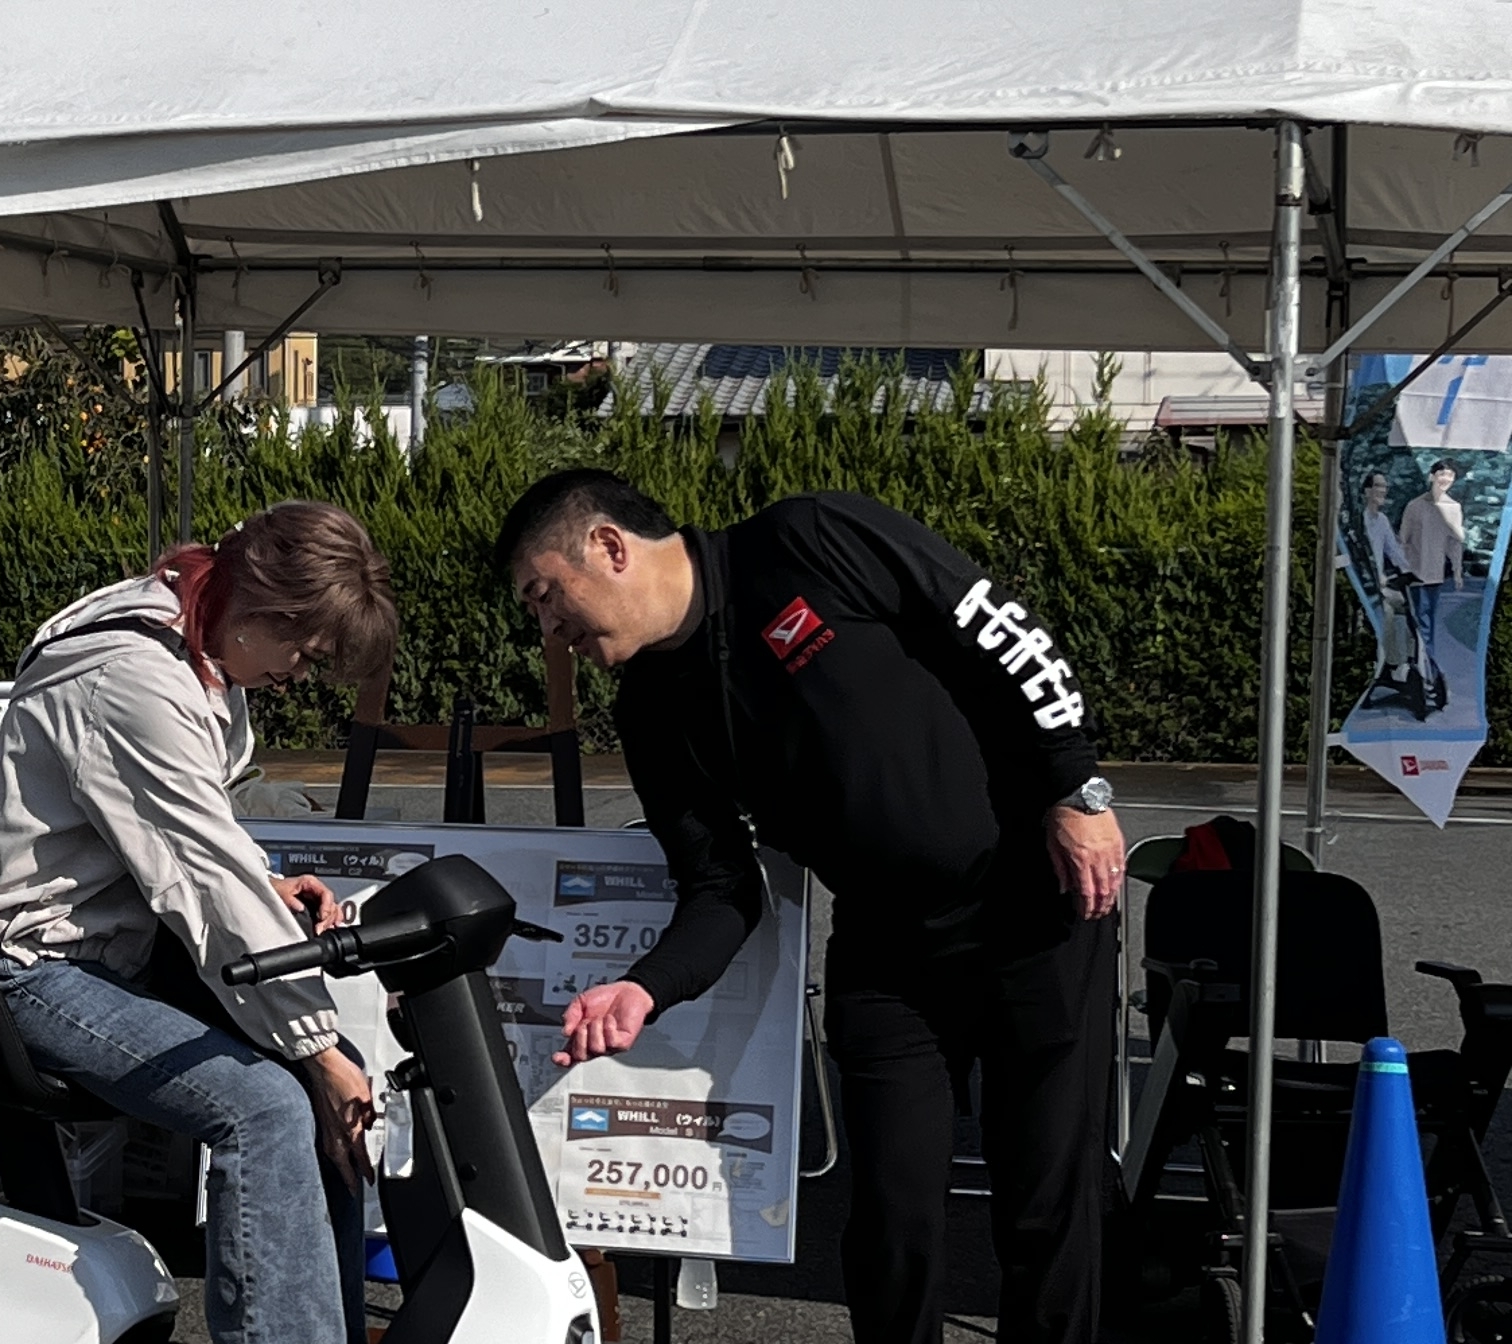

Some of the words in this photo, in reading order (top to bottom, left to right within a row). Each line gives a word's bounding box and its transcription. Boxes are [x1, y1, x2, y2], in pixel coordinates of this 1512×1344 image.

[288, 853, 328, 865] WHILL
[603, 875, 646, 889] WHILL
[573, 923, 664, 954] 357,0
[617, 1110, 660, 1124] WHILL
[649, 1125, 678, 1136] Model
[587, 1158, 708, 1191] 257,000
